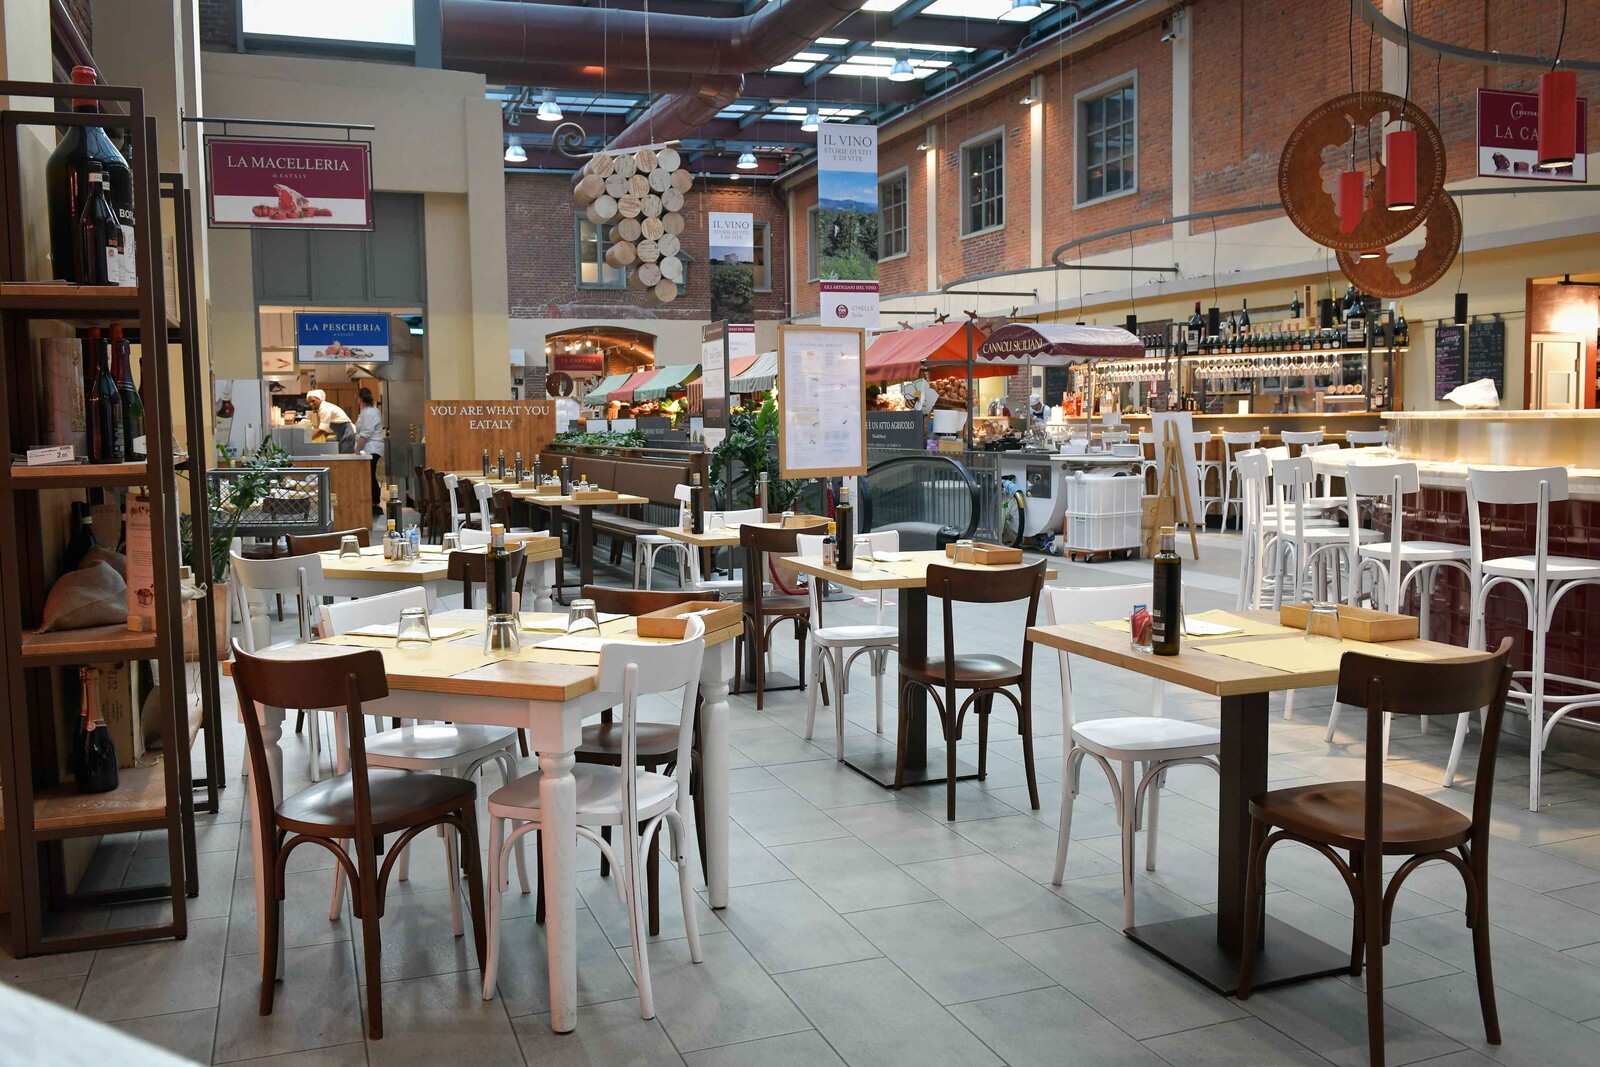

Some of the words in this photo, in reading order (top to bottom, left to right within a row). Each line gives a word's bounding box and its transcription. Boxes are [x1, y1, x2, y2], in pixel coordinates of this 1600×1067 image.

[1495, 124, 1514, 139] LA
[1520, 126, 1539, 141] CA
[824, 134, 836, 146] IL
[838, 135, 872, 148] VINO
[227, 156, 248, 168] LA
[251, 156, 350, 171] MACELLERIA
[1408, 195, 1435, 230] PECORINO
[713, 220, 722, 228] IL
[724, 220, 750, 230] VINO
[305, 323, 318, 331] LA
[322, 323, 380, 332] PESCHERIA
[982, 341, 1012, 354] CANNOLI
[1013, 338, 1043, 351] SICILIANI
[430, 406, 456, 416] YOU
[460, 406, 484, 416] ARE
[486, 406, 522, 416] WHAT
[524, 406, 550, 416] YOU
[469, 420, 513, 430] EATALY
[879, 422, 890, 430] ATTO
[891, 421, 914, 430] AGRICOLO
[108, 670, 118, 690] 2012
